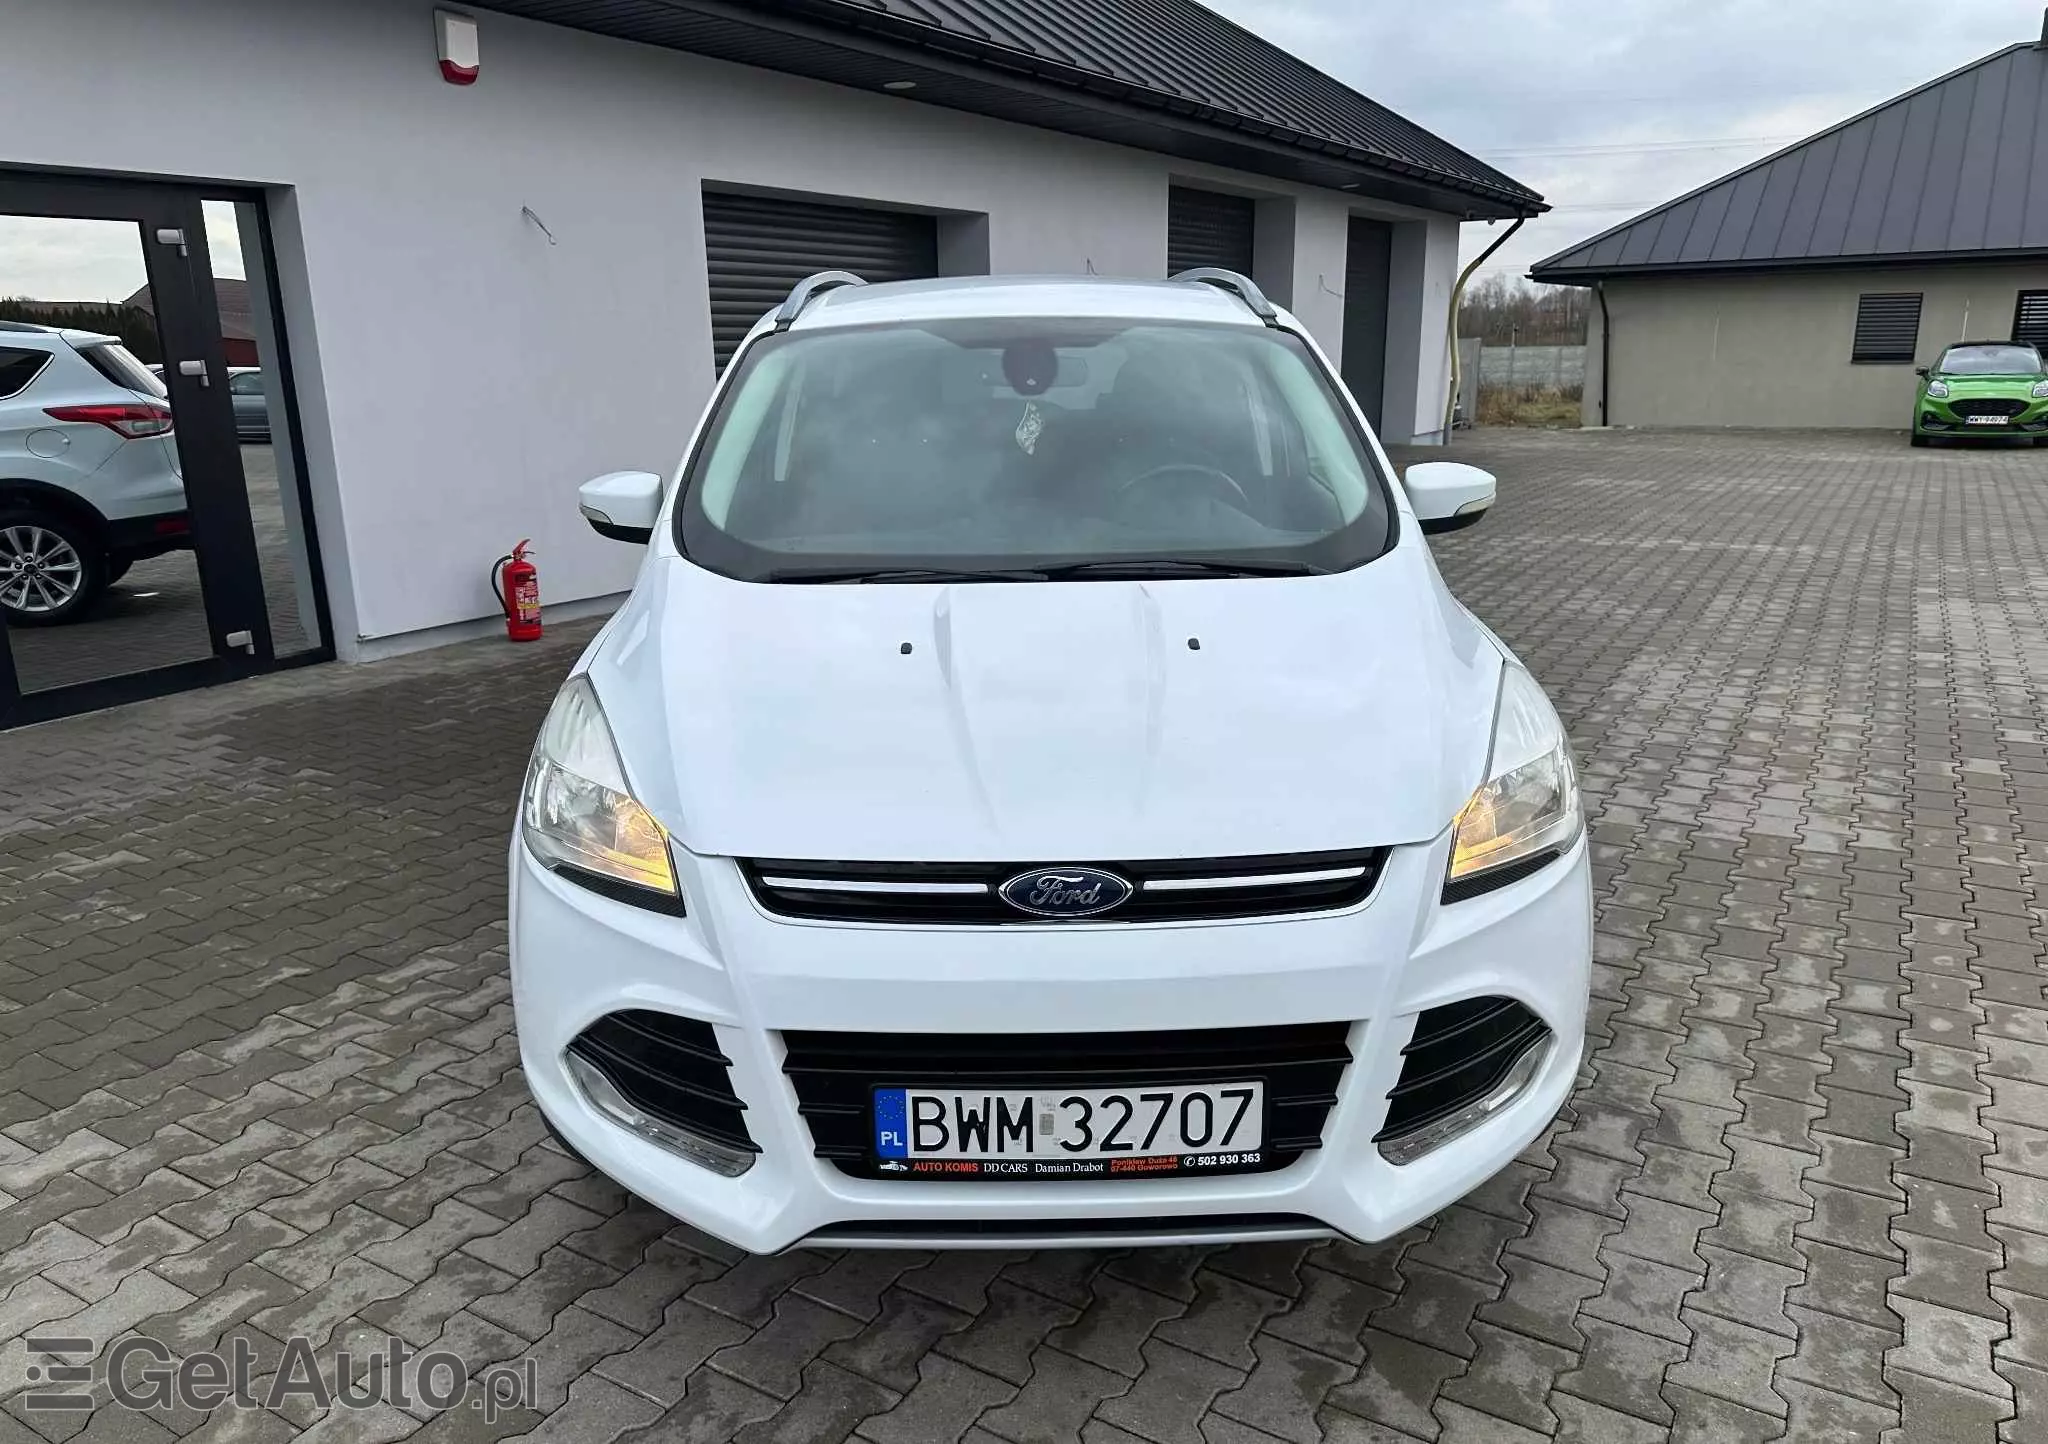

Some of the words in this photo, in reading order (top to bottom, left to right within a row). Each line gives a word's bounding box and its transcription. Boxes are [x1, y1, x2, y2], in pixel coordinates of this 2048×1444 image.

[1030, 875, 1102, 905] Ford
[911, 1096, 1034, 1152] BWM
[1059, 1088, 1254, 1152] 32707
[880, 1131, 903, 1146] PL
[1198, 1156, 1217, 1165] 502
[1220, 1154, 1239, 1164] 930
[1242, 1153, 1260, 1163] 363
[913, 1162, 943, 1172] AUTO
[945, 1162, 979, 1172] KOMIS
[984, 1163, 999, 1173] DD
[1001, 1162, 1028, 1173] CARS
[1035, 1163, 1071, 1173] Damian
[1073, 1162, 1104, 1172] Drabot
